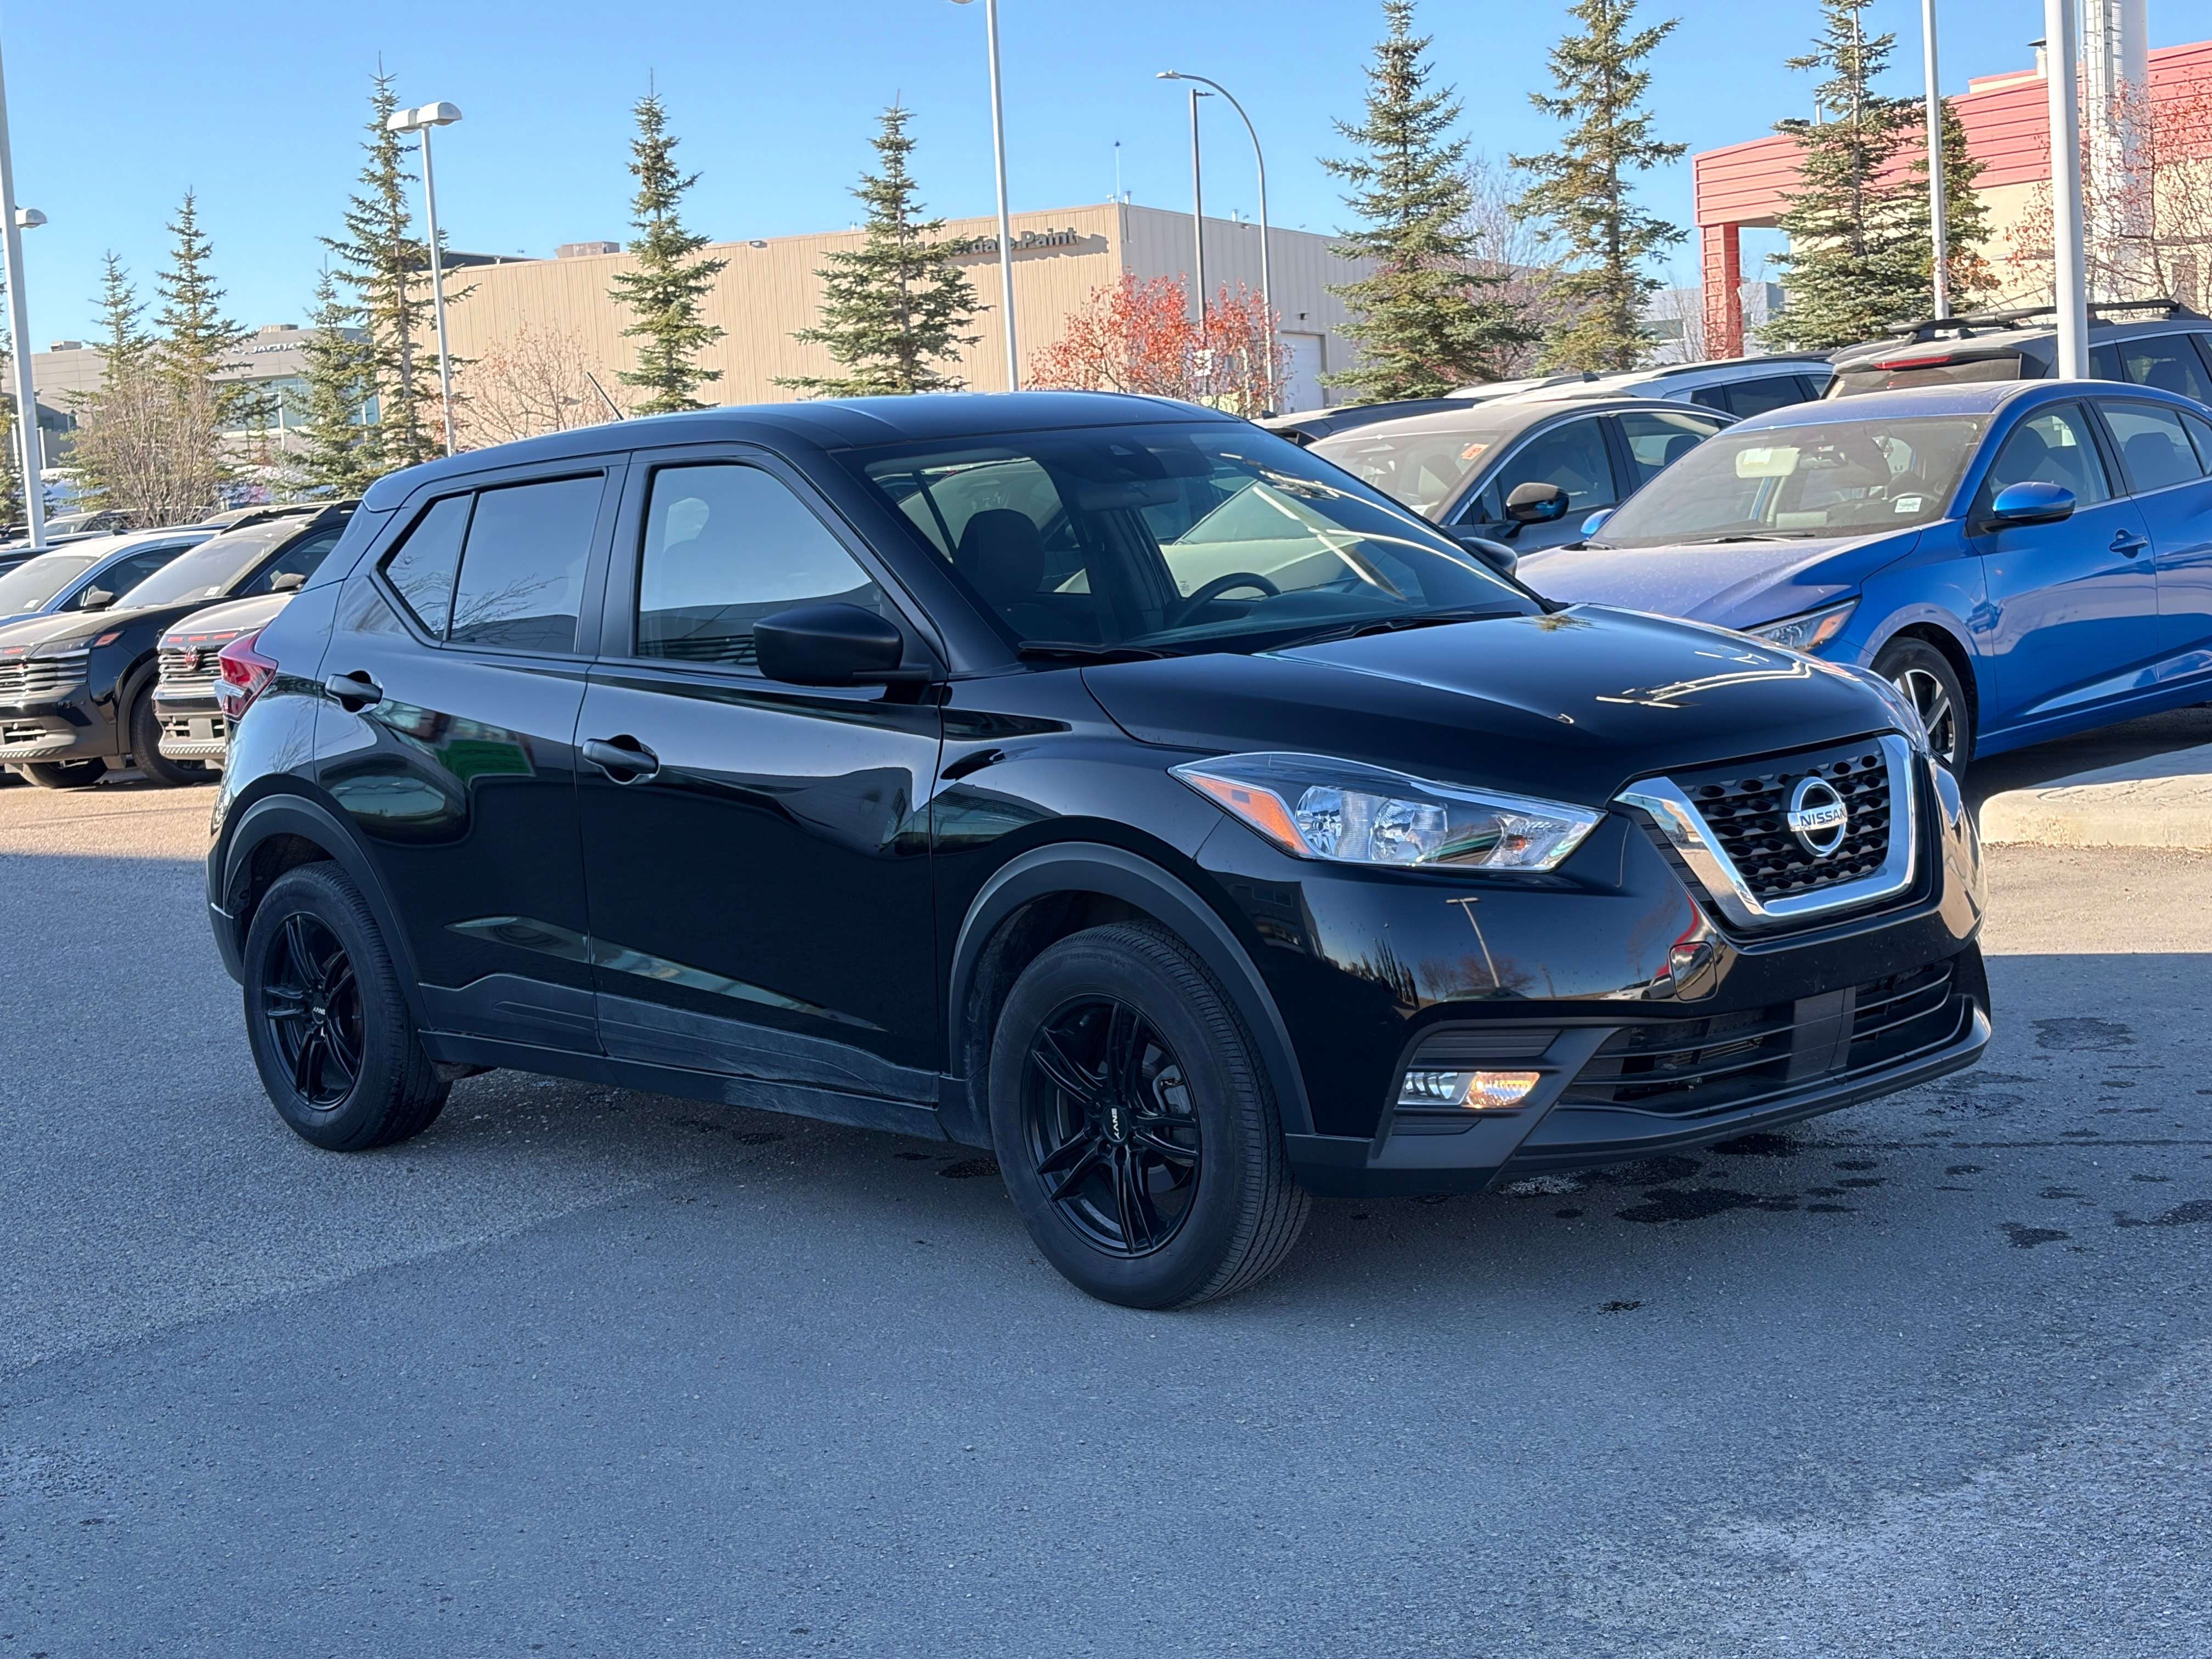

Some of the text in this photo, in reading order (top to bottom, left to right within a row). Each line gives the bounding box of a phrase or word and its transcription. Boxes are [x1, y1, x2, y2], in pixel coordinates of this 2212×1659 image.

[1020, 227, 1076, 249] Paint
[1799, 808, 1847, 826] NISSAN
[1111, 1108, 1120, 1139] ENVY
